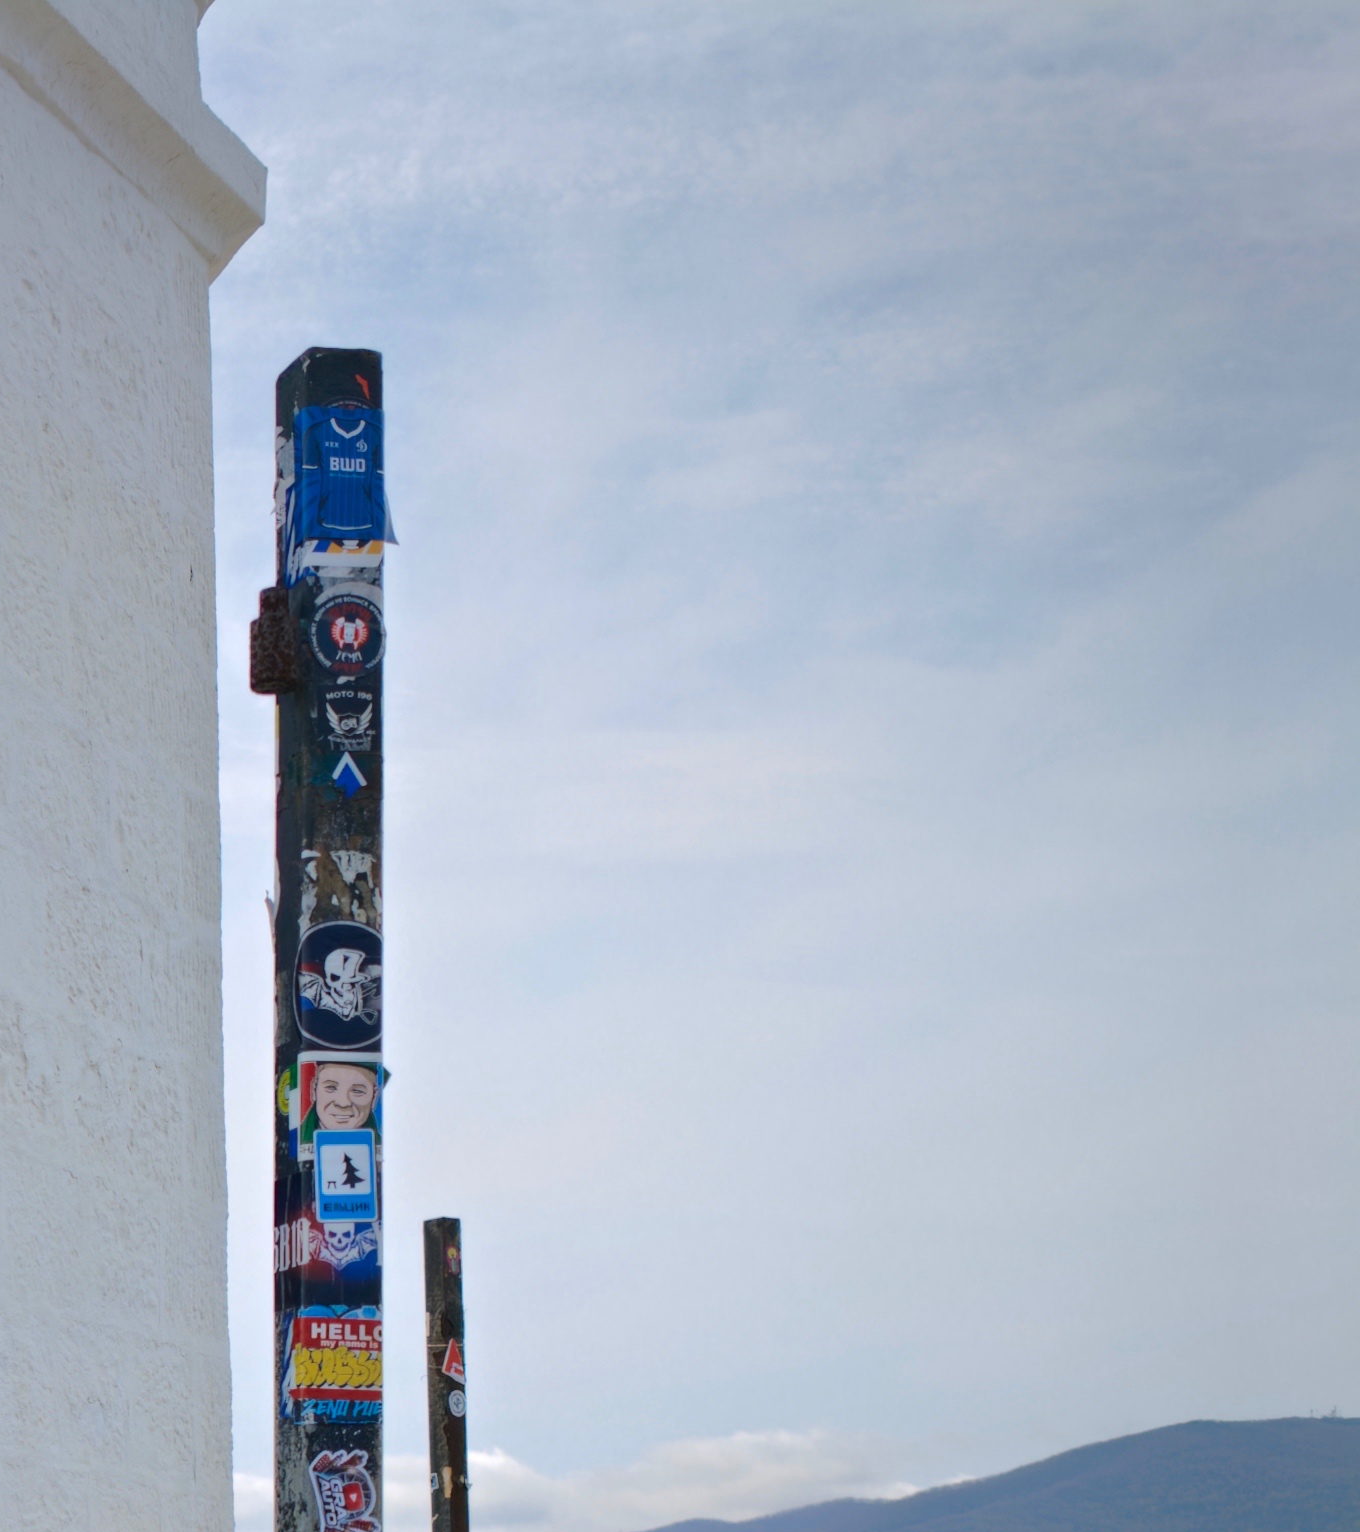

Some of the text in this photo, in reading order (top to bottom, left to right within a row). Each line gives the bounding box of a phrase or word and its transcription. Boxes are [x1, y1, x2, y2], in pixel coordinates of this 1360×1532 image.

[326, 691, 354, 699] MOTO
[320, 1340, 379, 1348] my name is
[318, 1475, 337, 1526] AUTO
